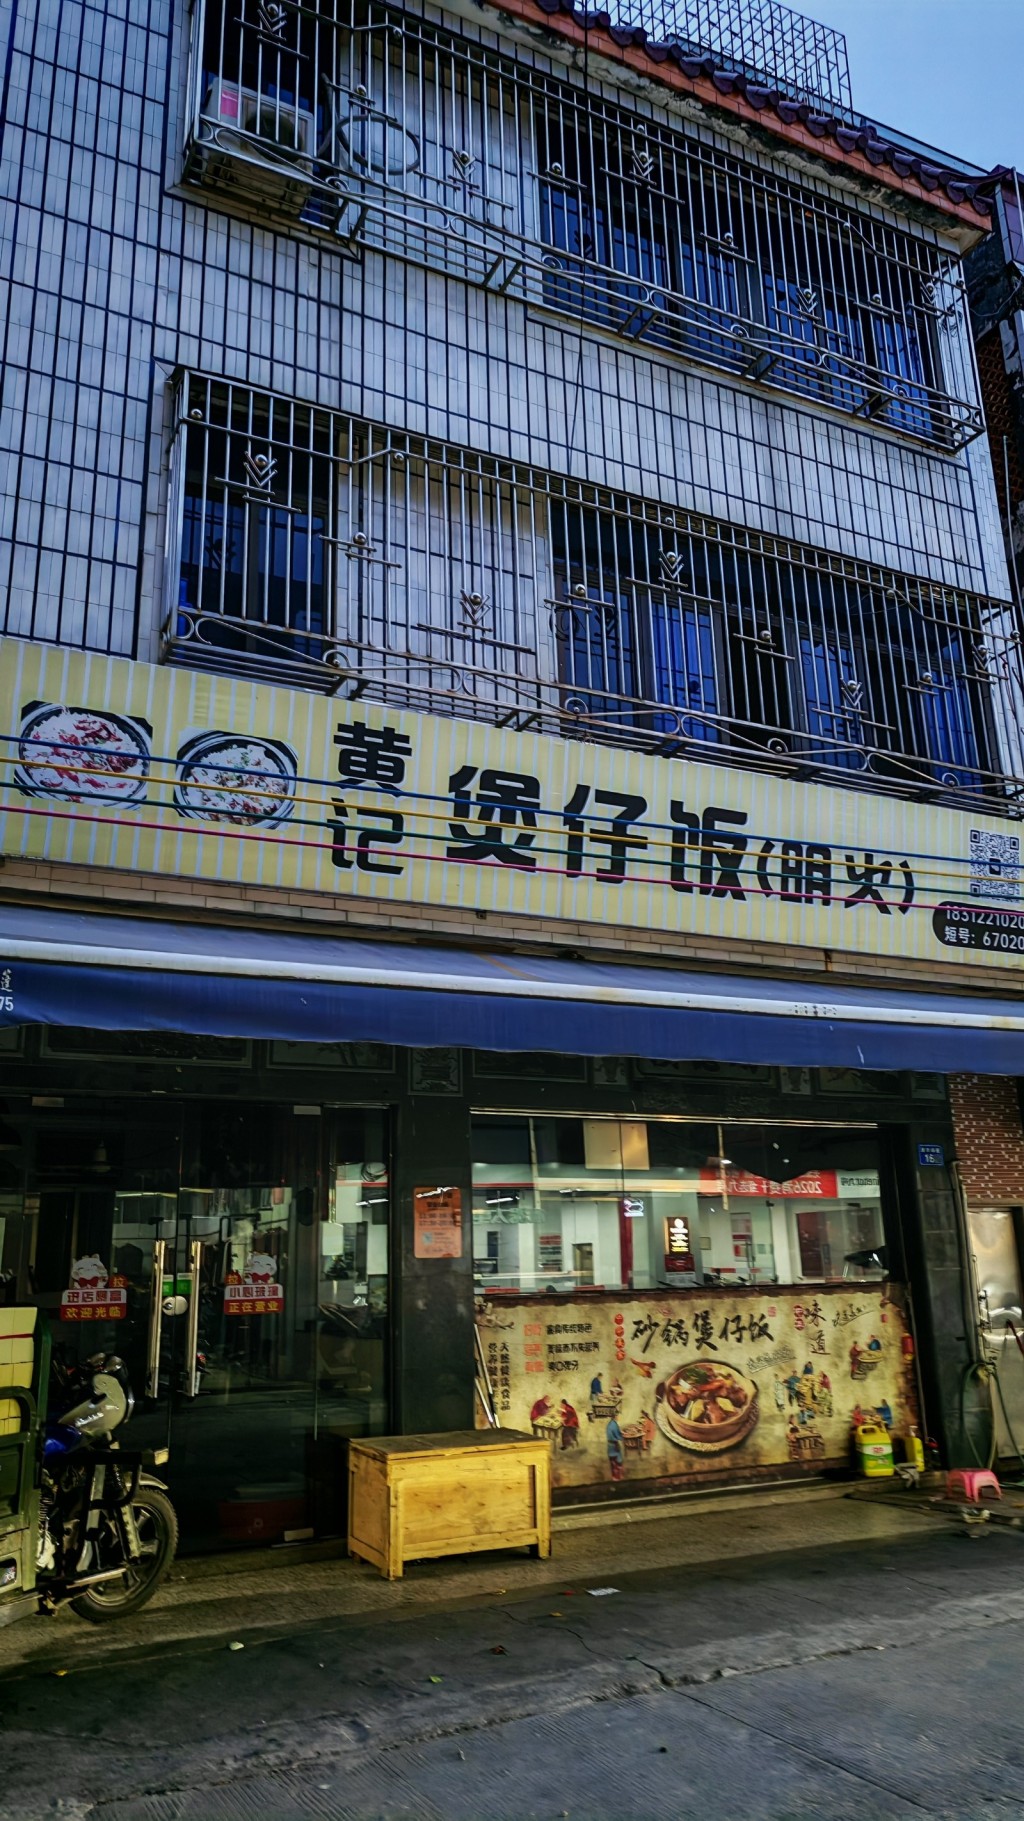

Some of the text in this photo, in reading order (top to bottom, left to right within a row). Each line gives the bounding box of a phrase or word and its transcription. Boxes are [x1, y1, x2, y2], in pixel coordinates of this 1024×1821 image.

[329, 720, 413, 876] 黄记
[65, 1306, 121, 1319] 欢迎光临
[228, 1301, 279, 1313] 正在营业
[630, 1309, 774, 1354] 砂锅煲仔饭
